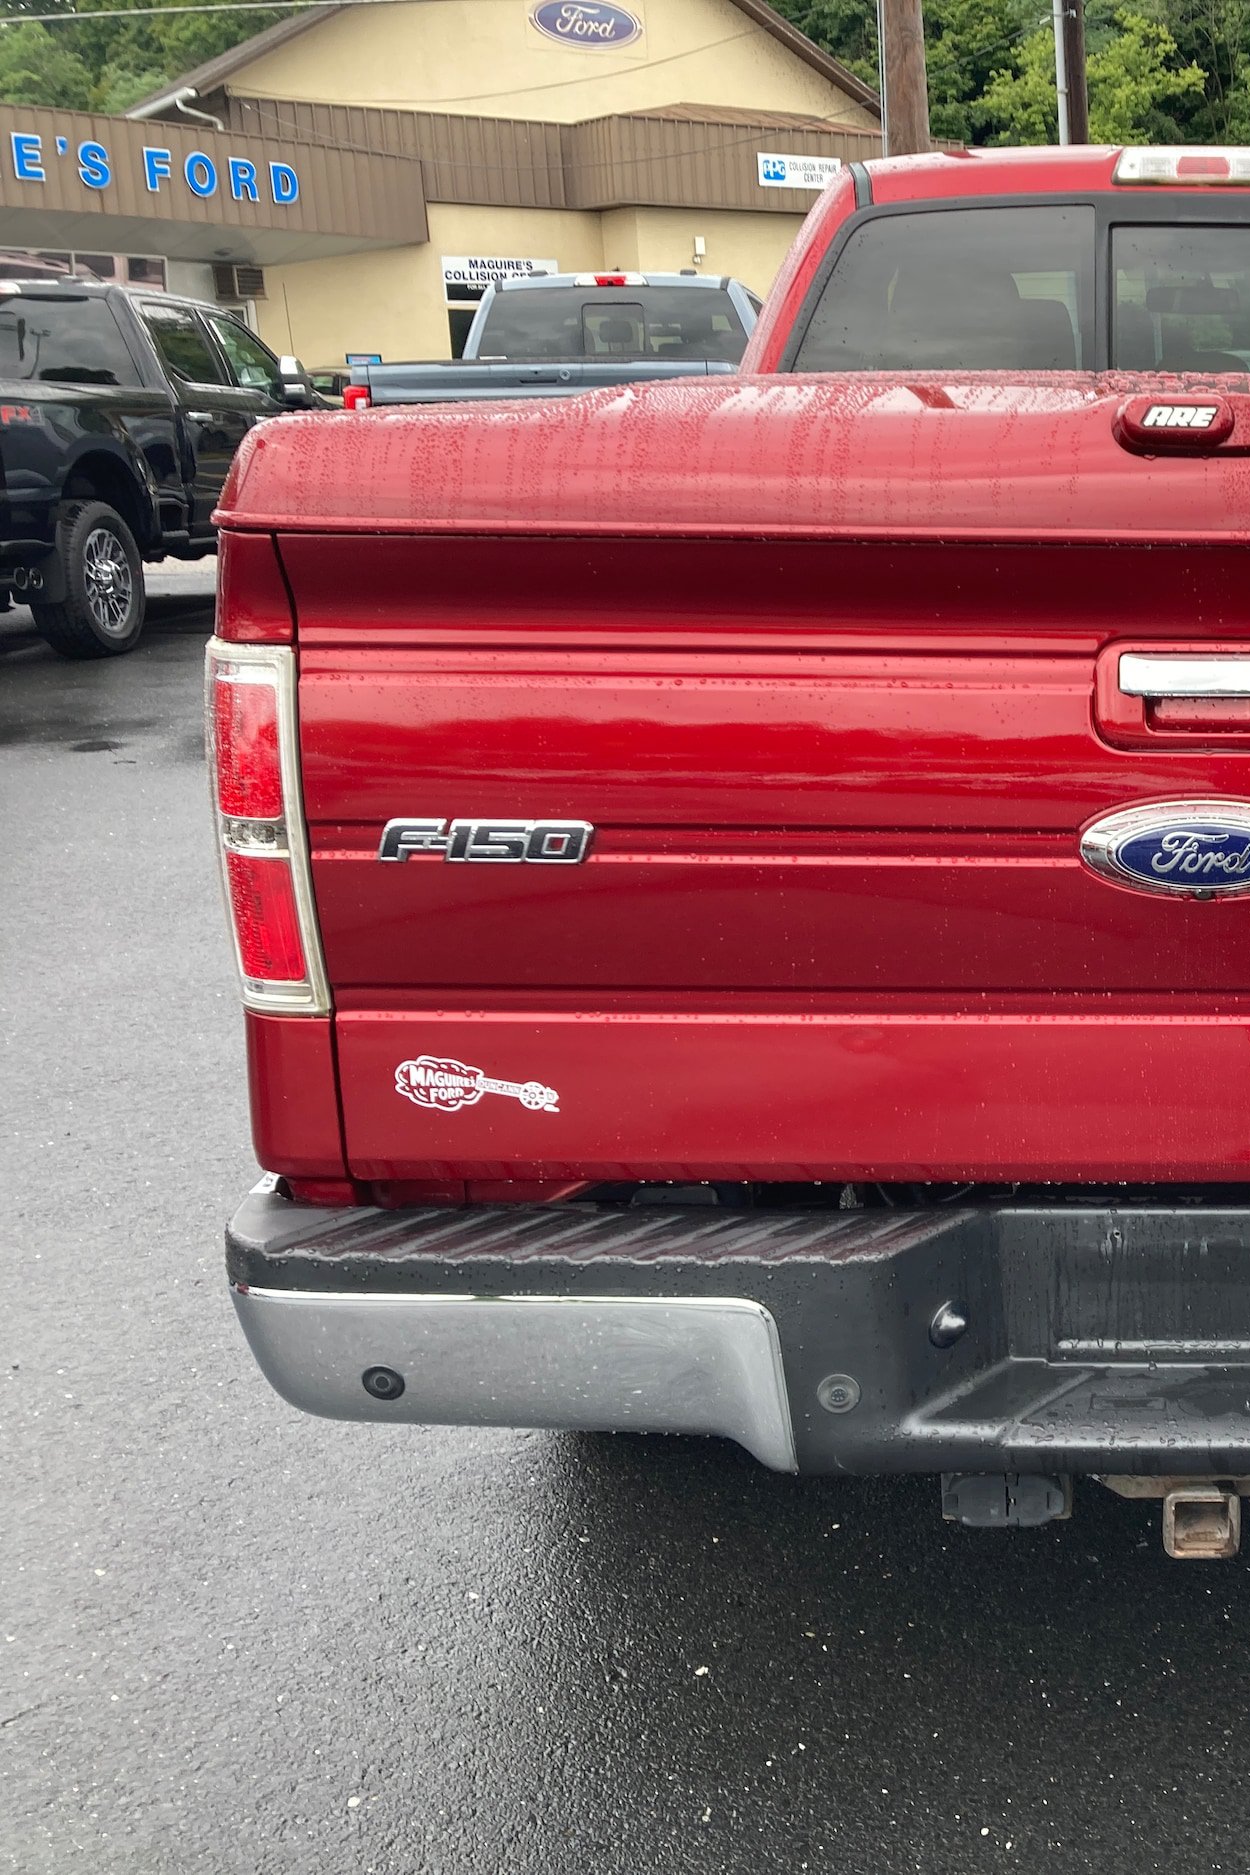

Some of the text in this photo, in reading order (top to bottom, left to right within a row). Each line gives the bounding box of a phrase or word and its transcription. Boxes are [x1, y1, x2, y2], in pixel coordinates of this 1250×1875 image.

[556, 4, 615, 38] Ford
[142, 146, 300, 205] FORD
[763, 160, 786, 180] PPG
[789, 161, 837, 174] COLLISION REPAIR
[803, 173, 824, 183] CENTER
[468, 258, 533, 271] MAGUIRE'S
[444, 270, 507, 281] COLLISION
[1143, 406, 1218, 427] ARE
[378, 817, 595, 865] F-150
[429, 1087, 465, 1103] FORD
